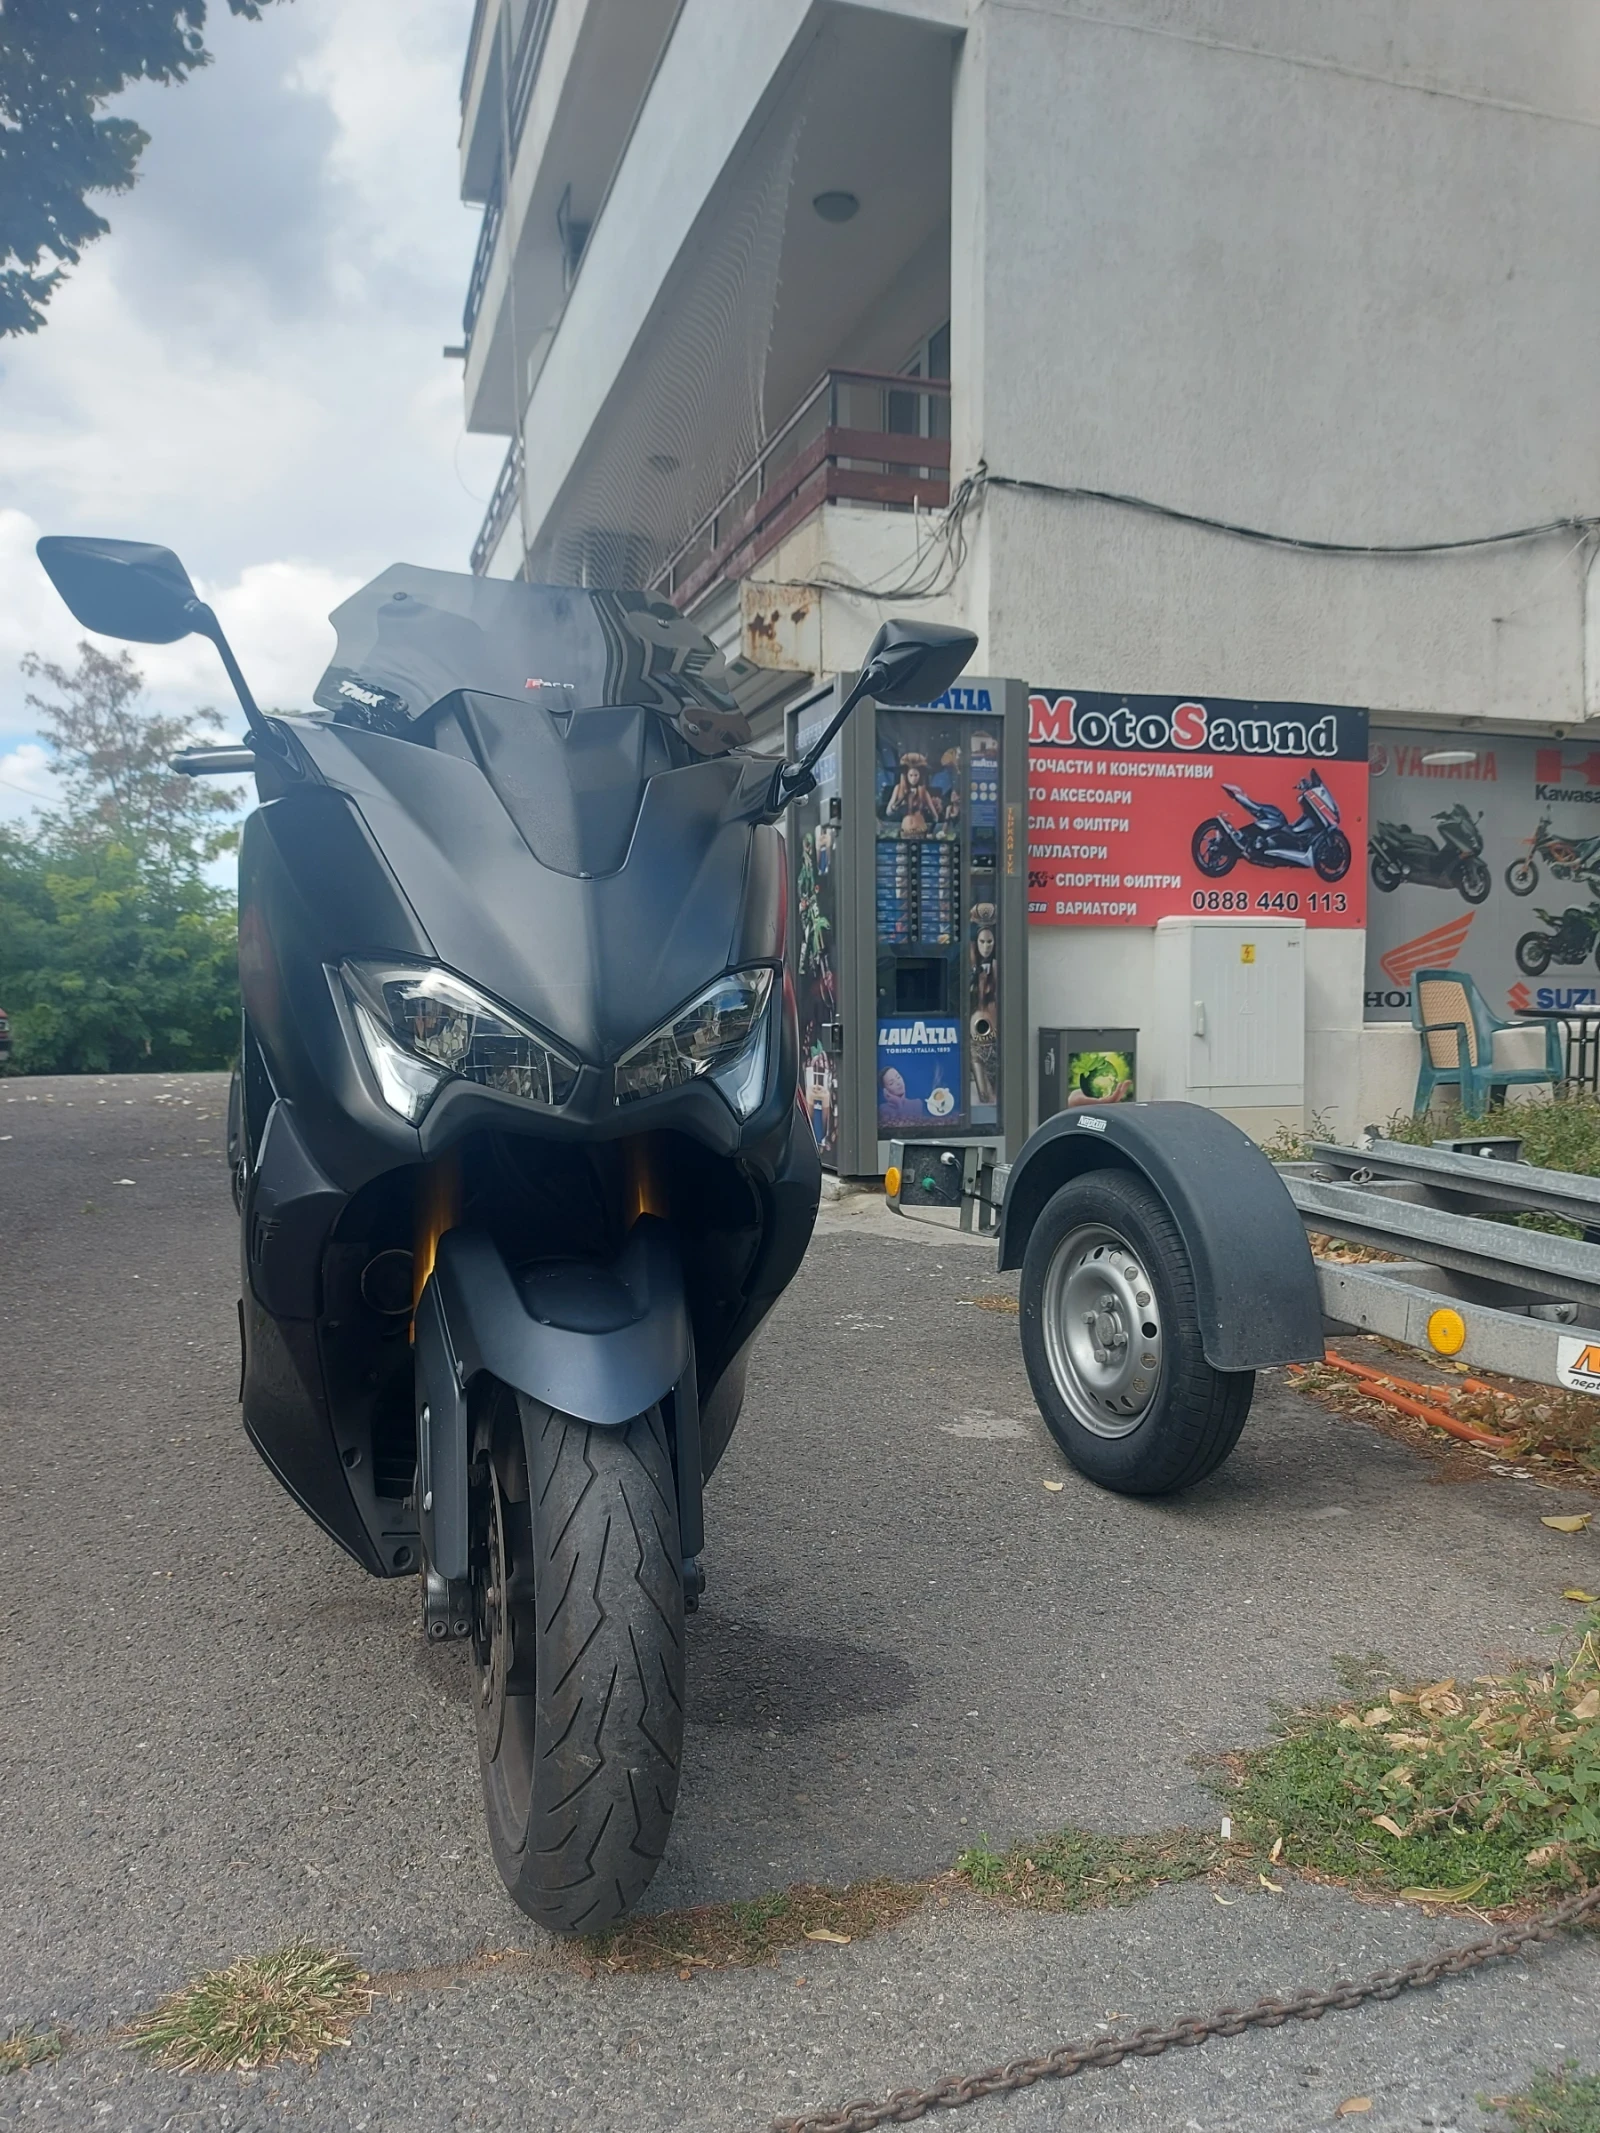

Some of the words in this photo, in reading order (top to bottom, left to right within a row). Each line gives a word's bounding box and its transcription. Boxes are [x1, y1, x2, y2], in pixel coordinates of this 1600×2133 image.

[1028, 695, 1338, 756] MotoSaund
[1097, 761, 1106, 775] И
[1110, 762, 1213, 779] КОНСУМАТИВИ
[1050, 788, 1132, 804] АКСЕСОАРИ
[1059, 817, 1069, 830] И
[1073, 817, 1129, 832] ФИЛТРИ
[1056, 873, 1120, 888] СПОРТНИ
[1124, 875, 1181, 889] ФИЛТРИ
[1056, 901, 1137, 916] ВАРИАТОРИ
[1192, 890, 1248, 910] 0888
[1256, 892, 1299, 912] 440
[1307, 892, 1347, 912] 113
[878, 1021, 958, 1046] LAVAZZA
